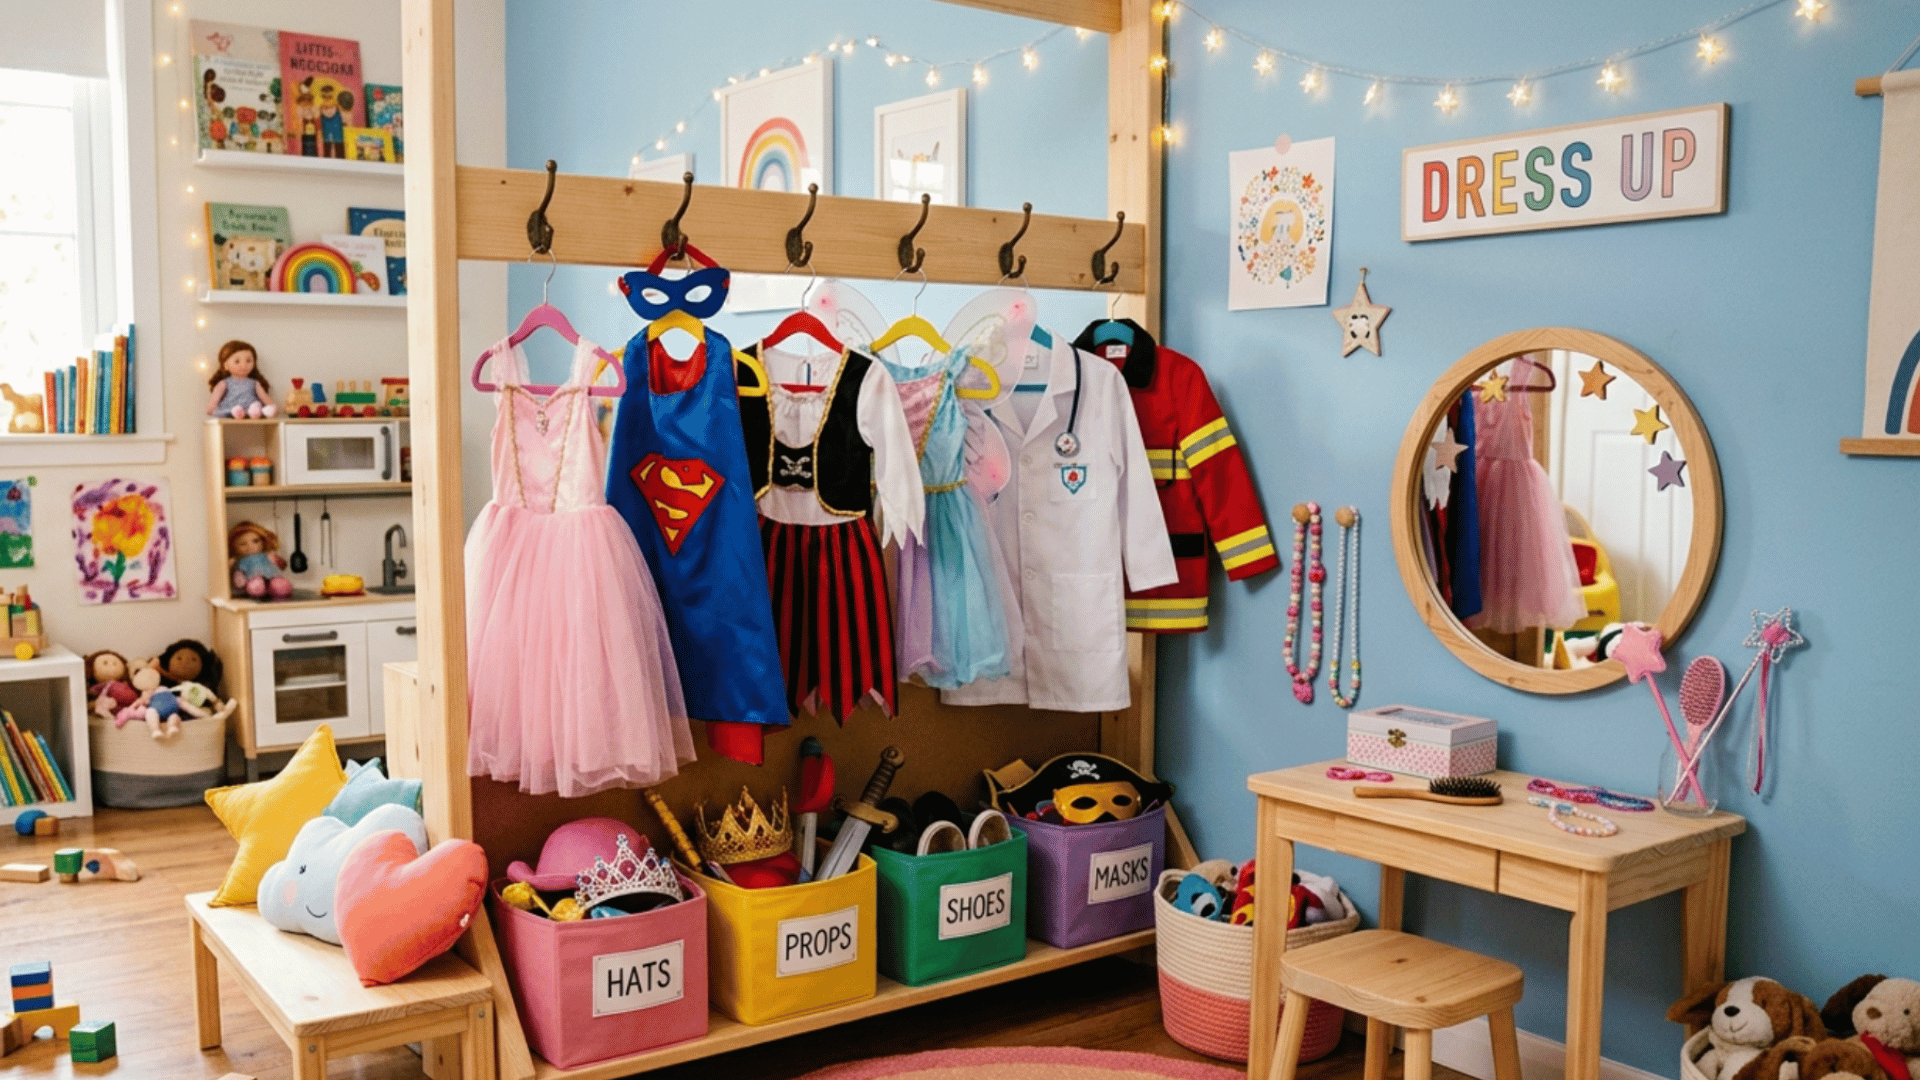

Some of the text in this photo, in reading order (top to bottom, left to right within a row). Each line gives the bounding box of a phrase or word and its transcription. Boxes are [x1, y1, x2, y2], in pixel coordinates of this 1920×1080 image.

[1422, 127, 1696, 223] DRESS UP
[1094, 857, 1149, 891] MASKS
[946, 889, 1005, 924] SHOES
[785, 922, 852, 961] PROPS
[607, 958, 671, 999] HATS
